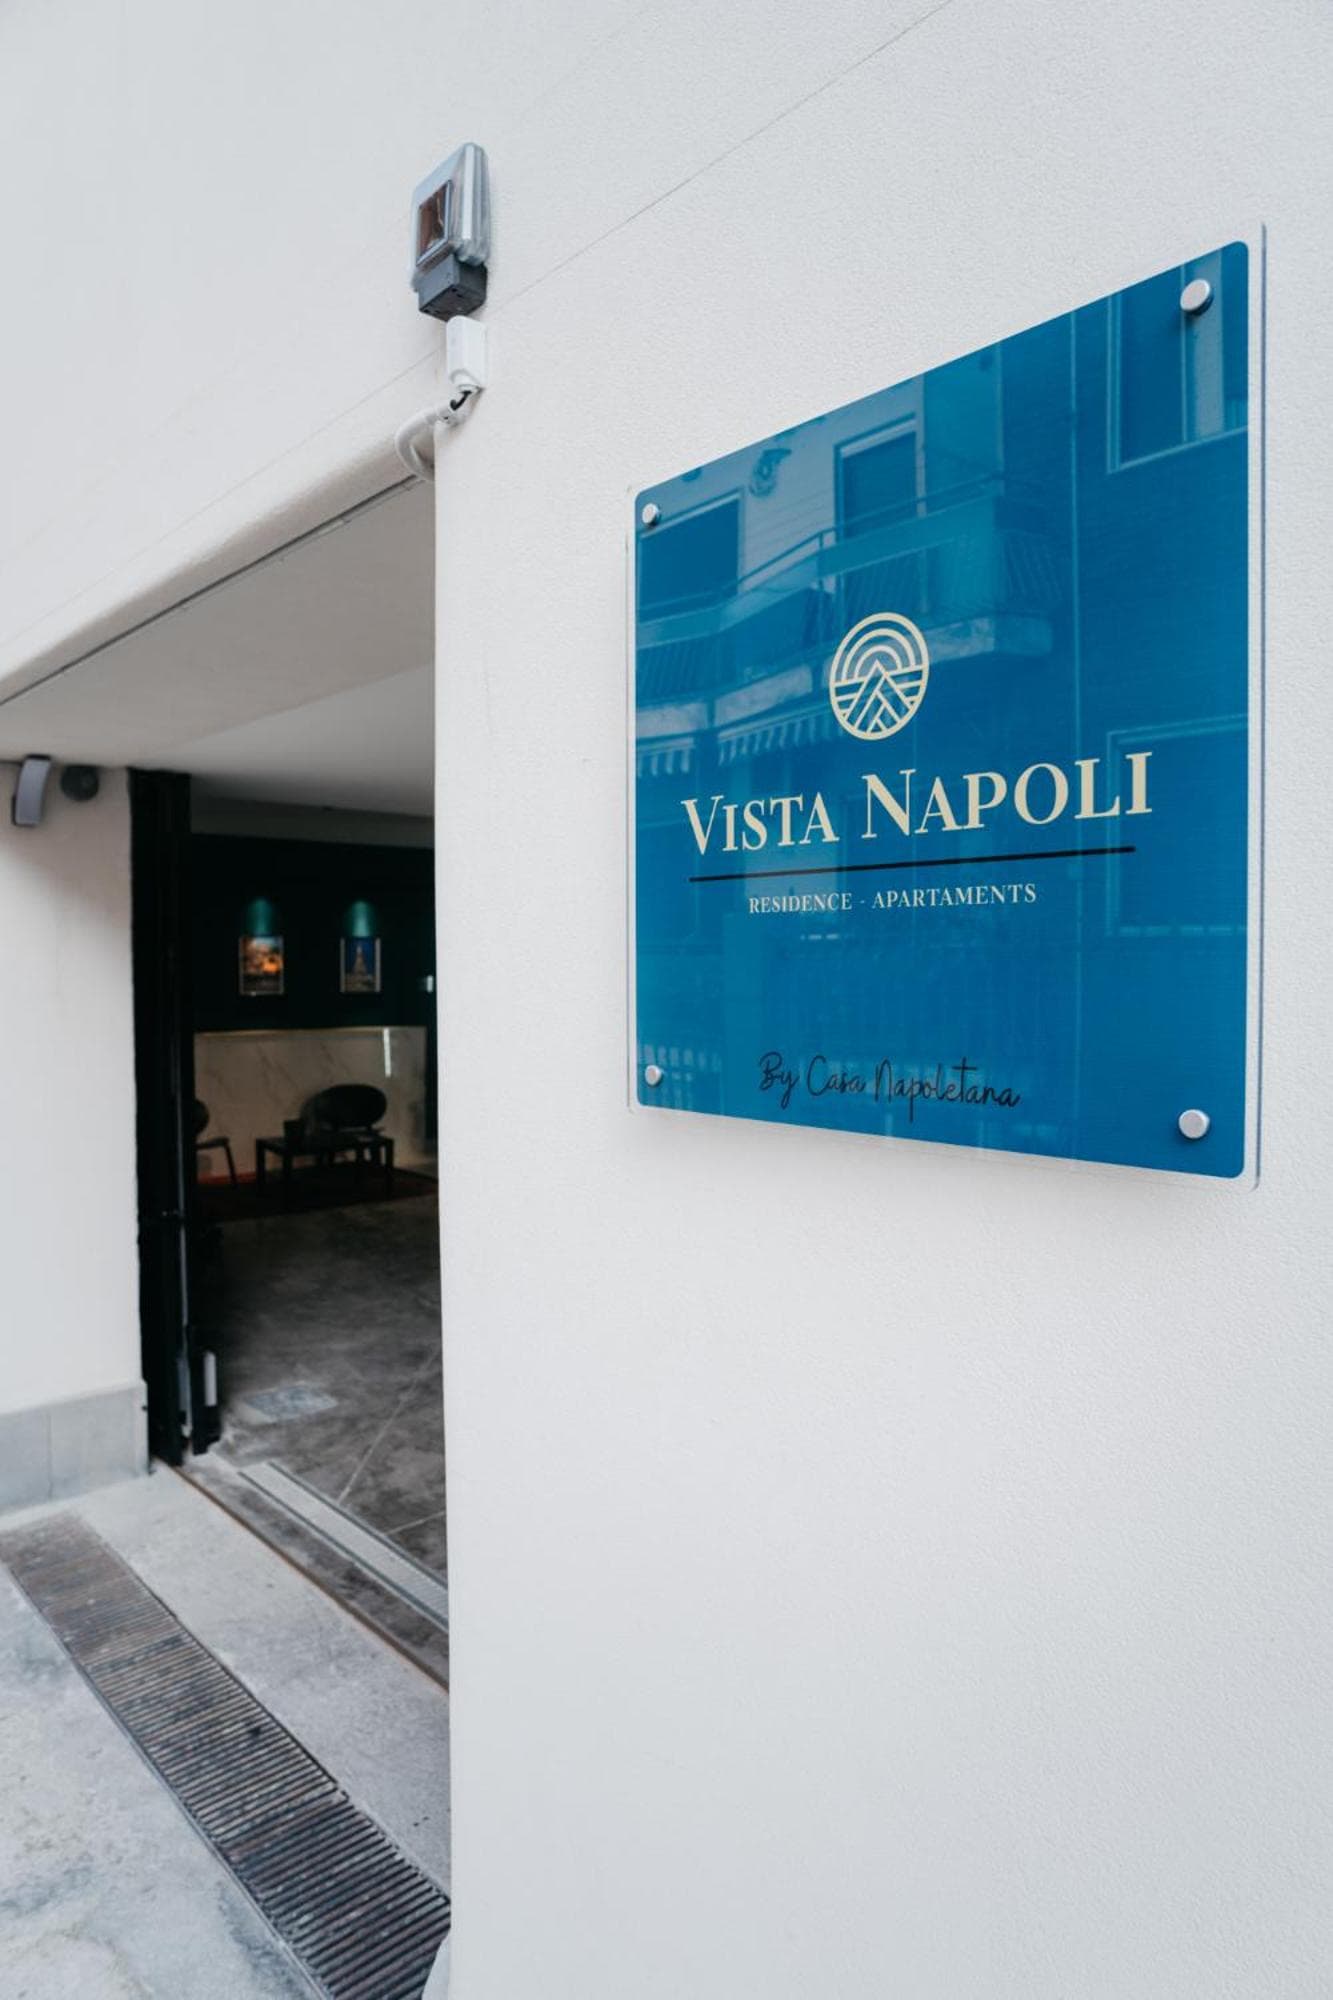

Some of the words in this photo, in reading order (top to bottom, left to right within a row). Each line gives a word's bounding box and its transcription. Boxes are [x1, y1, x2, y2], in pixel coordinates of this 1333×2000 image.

[681, 792, 839, 855] VISTA
[861, 751, 1153, 839] NAPOLI
[748, 892, 852, 913] RESIDENCE
[872, 883, 1037, 910] APARTAMENTS
[759, 1051, 799, 1110] By
[806, 1054, 865, 1096] Casa
[874, 1056, 1021, 1123] Napoletana
